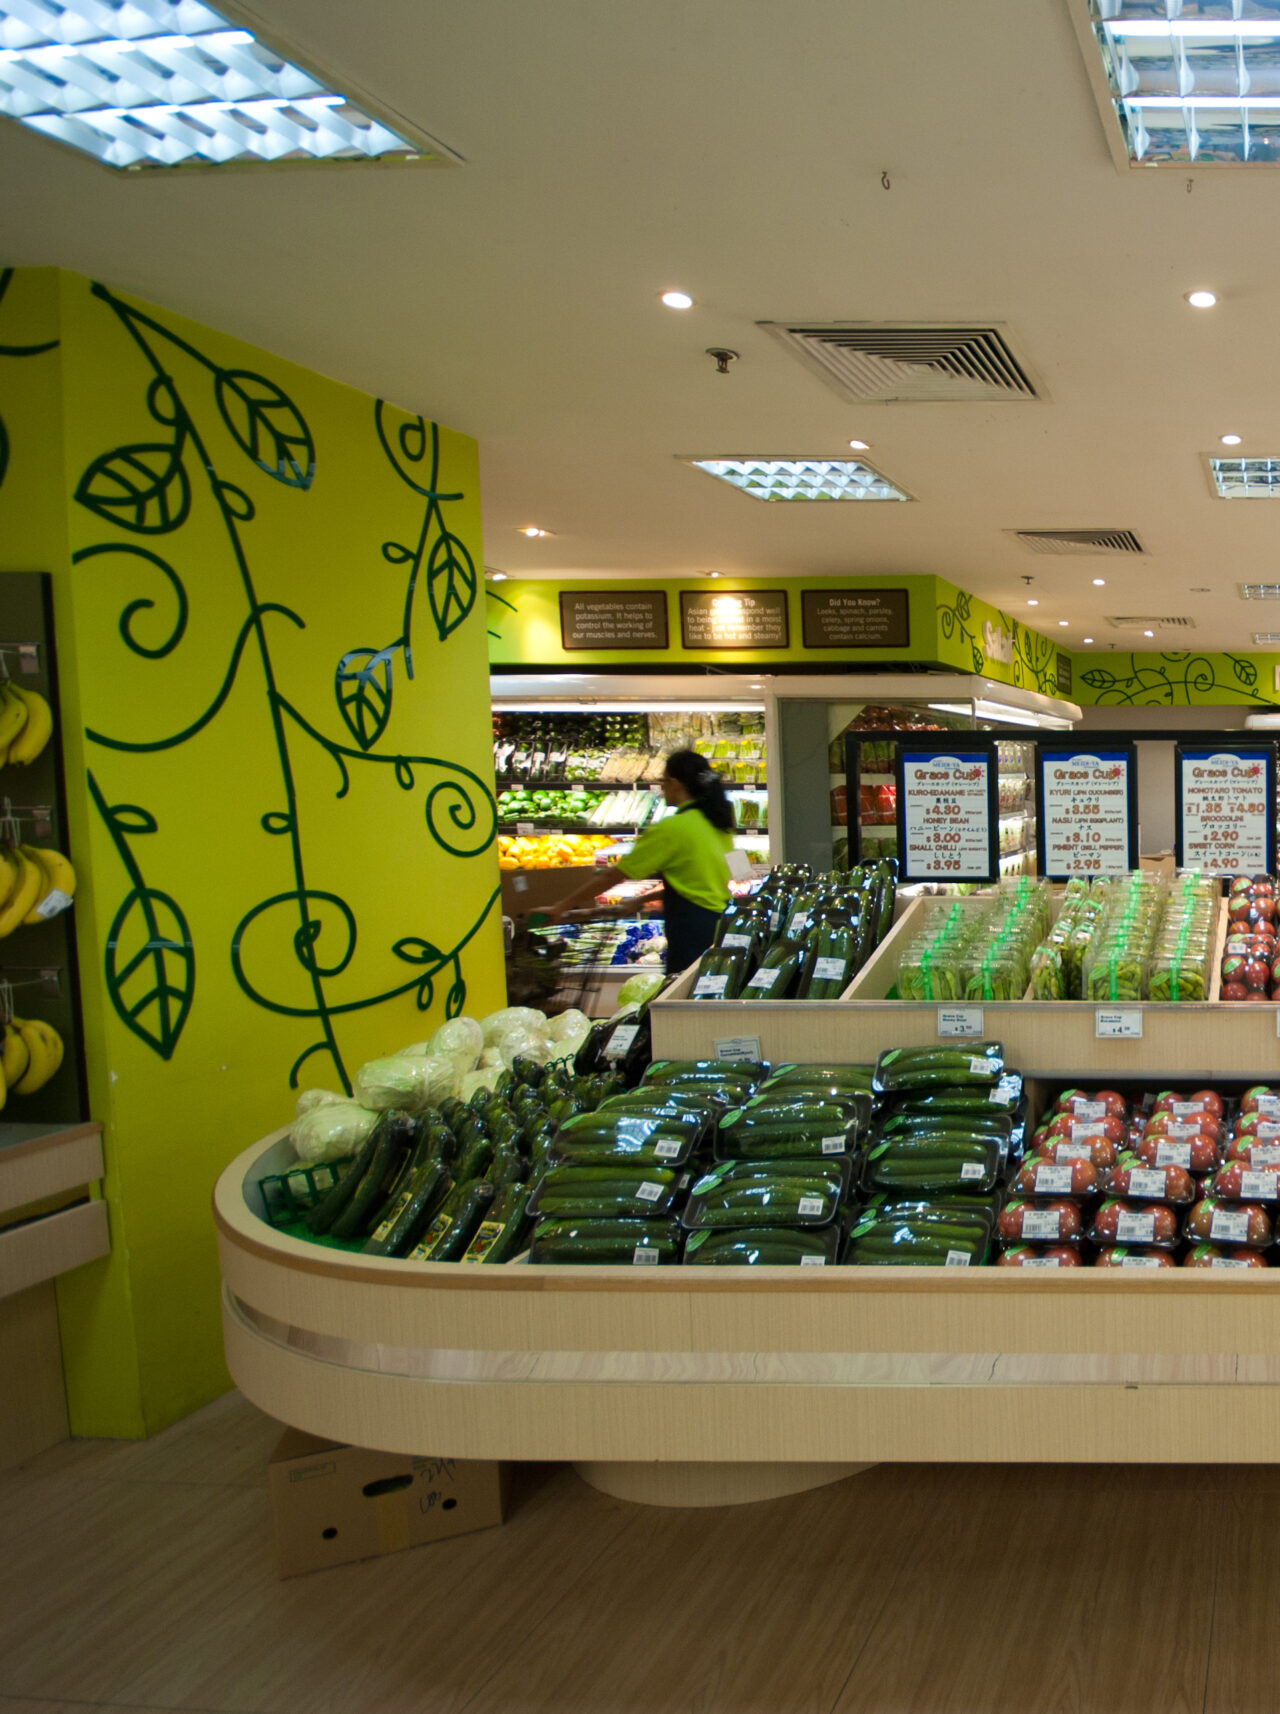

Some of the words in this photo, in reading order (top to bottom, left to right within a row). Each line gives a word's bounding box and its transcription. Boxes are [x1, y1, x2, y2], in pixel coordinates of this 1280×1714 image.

[744, 598, 756, 607] Tip
[586, 603, 624, 611] vegetables
[624, 613, 644, 621] helps
[616, 622, 644, 630] working
[586, 631, 615, 639] muscles
[914, 769, 950, 780] Grace
[953, 769, 977, 781] Cup
[1054, 768, 1089, 780] Grace
[1092, 768, 1116, 781] Cup
[1192, 766, 1228, 778] Grace
[1231, 766, 1255, 779] Cup
